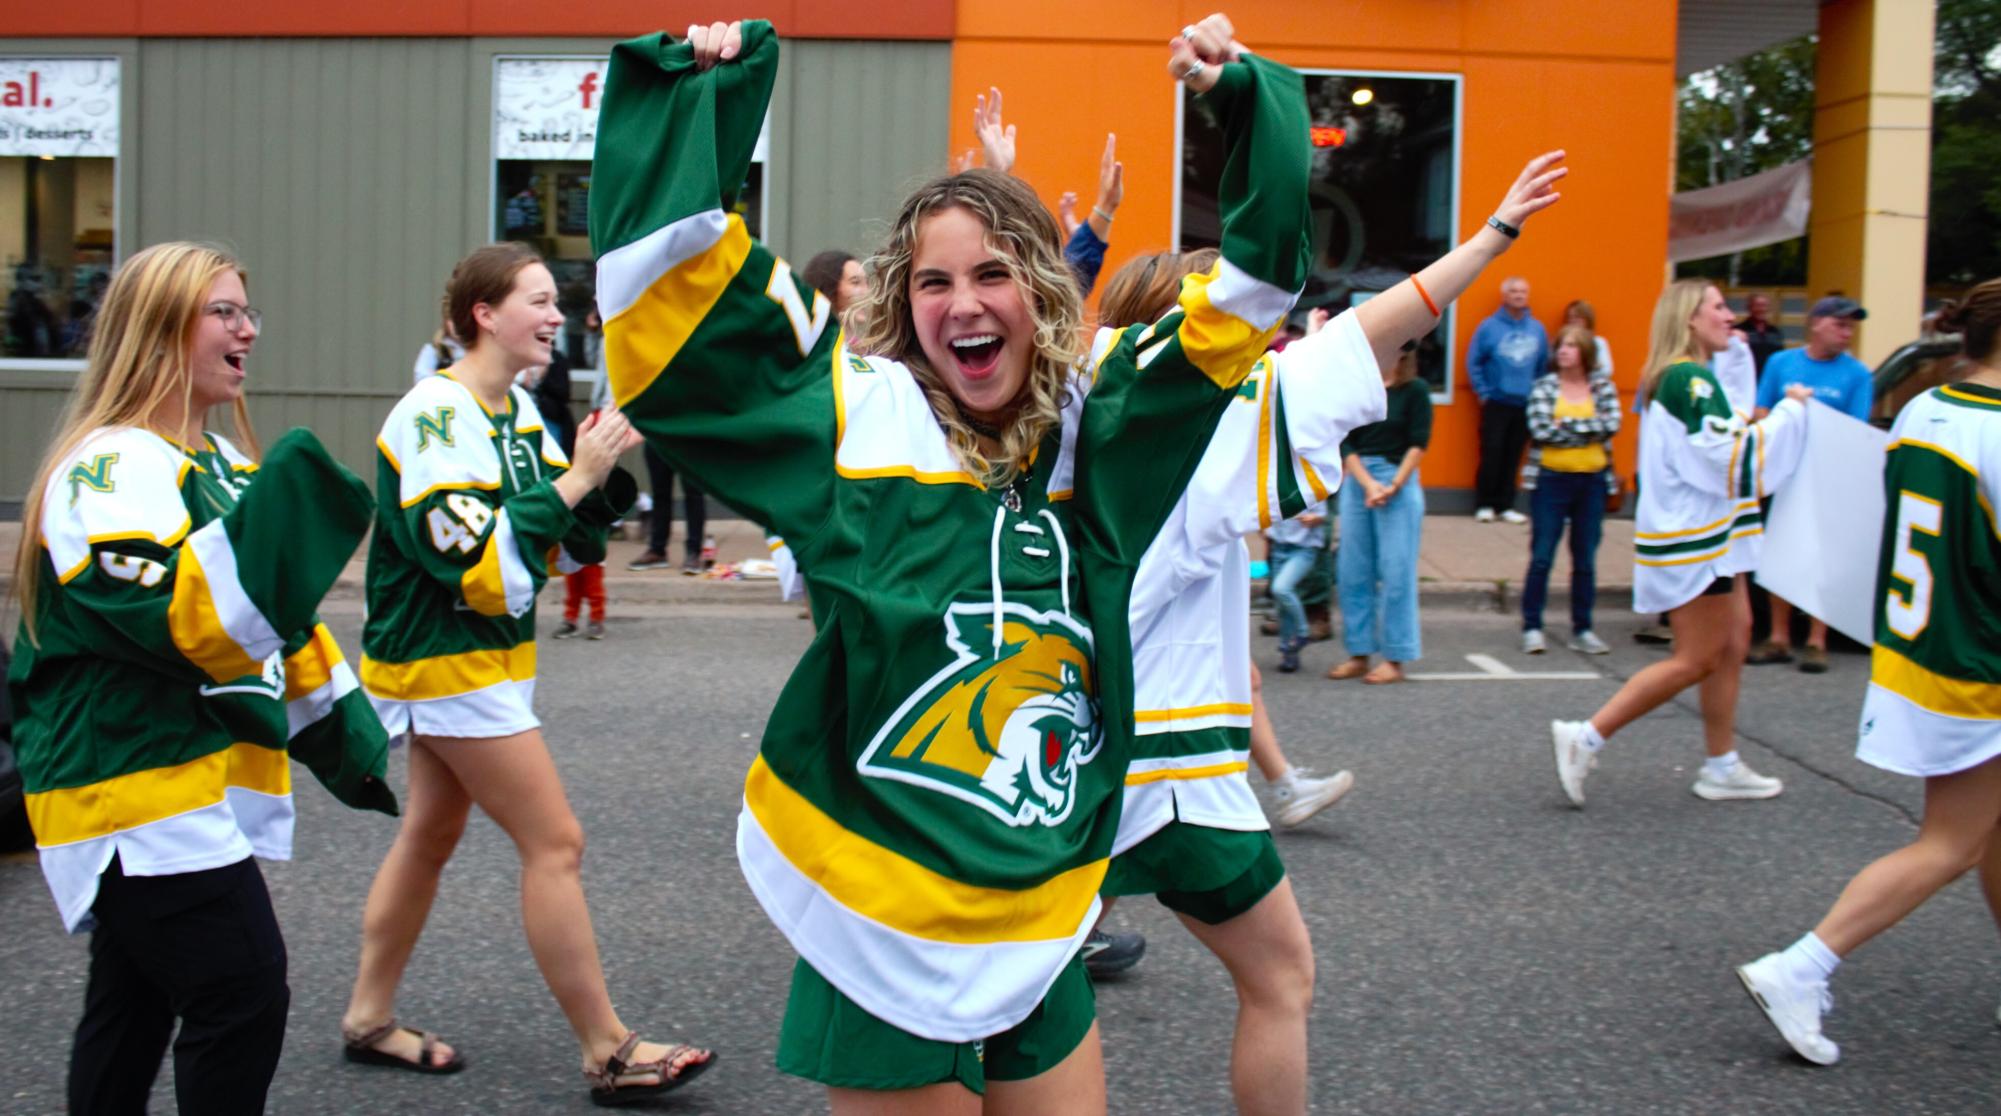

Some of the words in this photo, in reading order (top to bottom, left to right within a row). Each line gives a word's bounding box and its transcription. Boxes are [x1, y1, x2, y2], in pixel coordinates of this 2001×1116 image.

[2, 70, 53, 108] al.
[578, 71, 599, 109] f
[25, 125, 94, 141] desserts
[518, 127, 571, 142] baked
[1311, 127, 1347, 148] PEN
[414, 406, 456, 454] N
[426, 492, 494, 555] 48
[1885, 487, 1944, 642] 5
